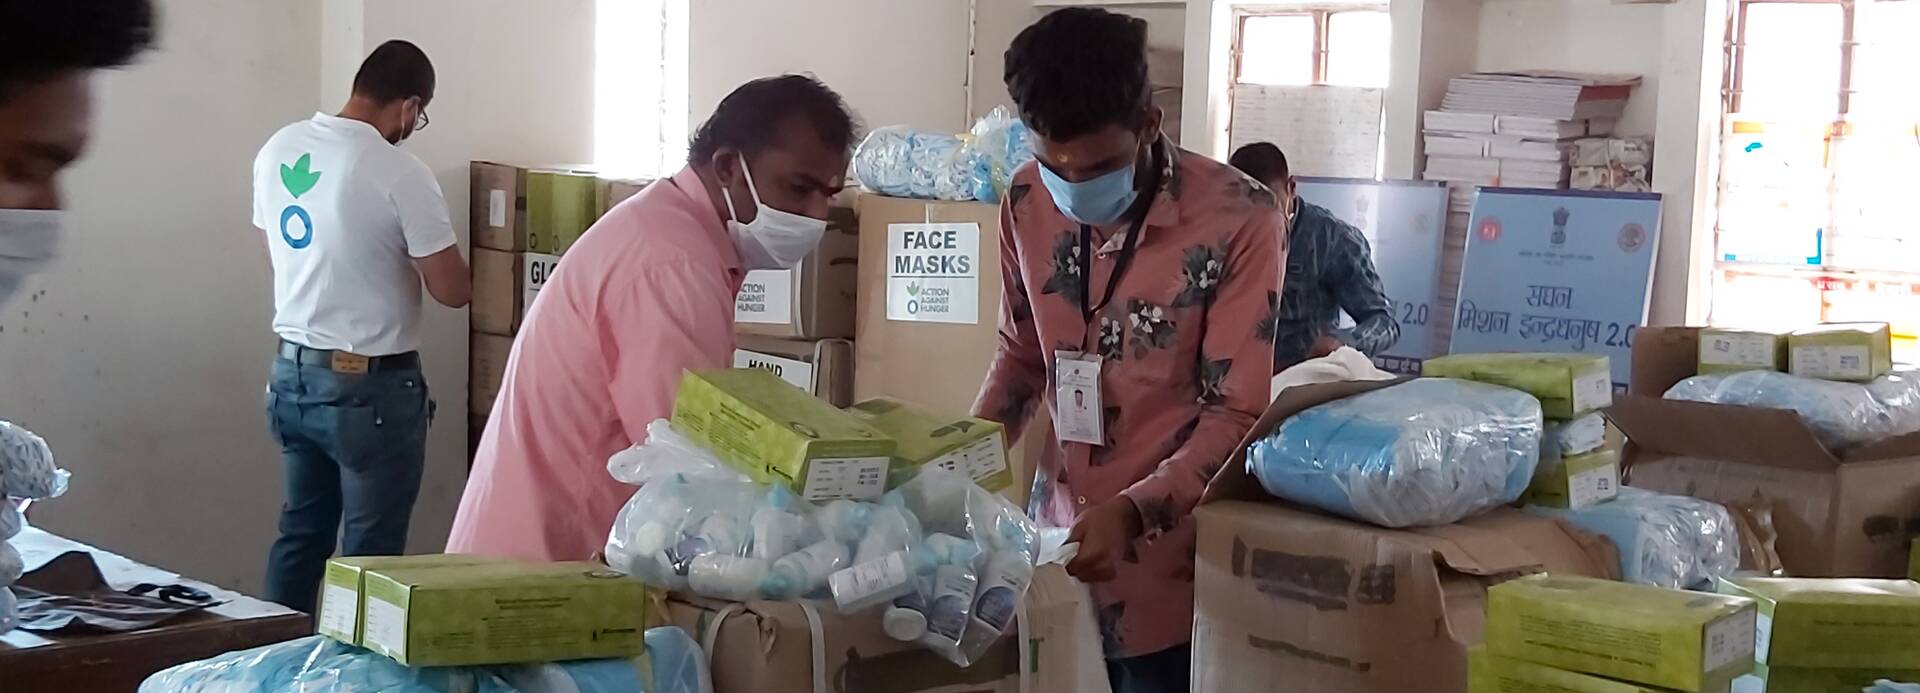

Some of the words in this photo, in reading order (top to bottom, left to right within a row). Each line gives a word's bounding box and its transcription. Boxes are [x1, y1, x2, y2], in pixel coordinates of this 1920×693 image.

[903, 230, 957, 249] FACE
[895, 255, 970, 274] MASKS
[741, 283, 765, 293] CTION
[921, 288, 949, 296] ACTION
[737, 303, 765, 312] HUNGER
[921, 304, 949, 313] HUNGER
[1402, 302, 1428, 325] 2.0
[748, 359, 783, 377] HAND
